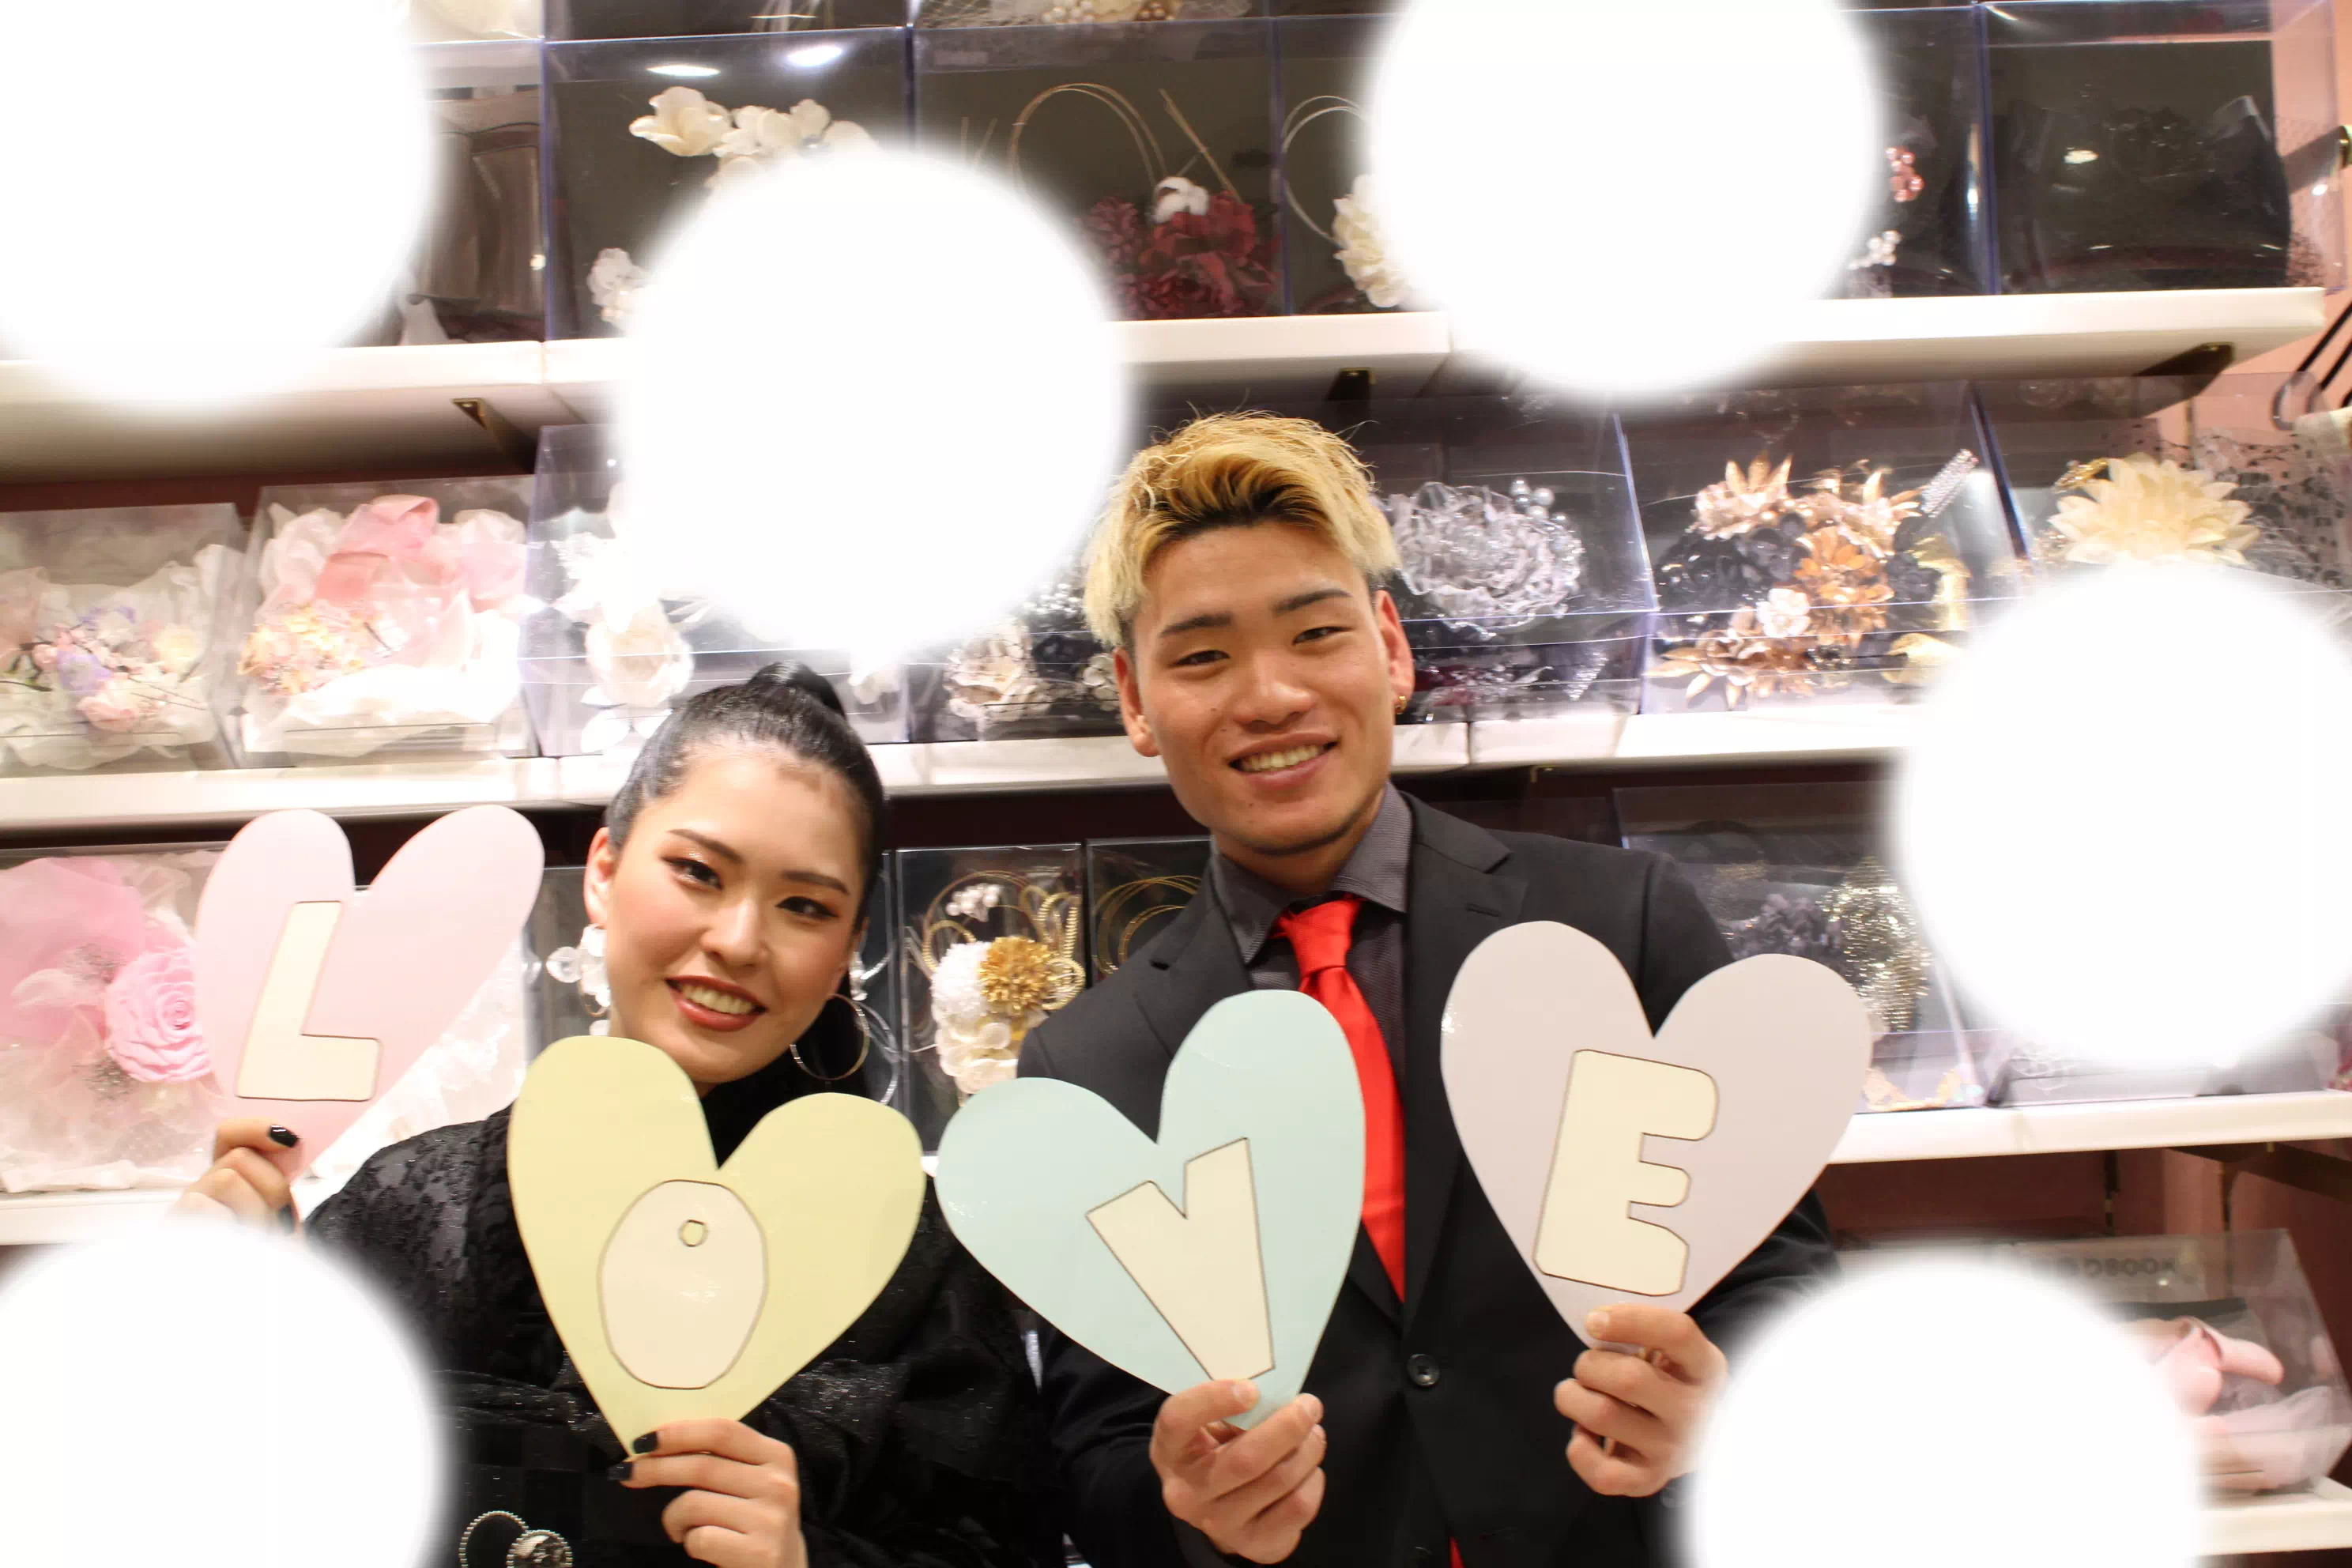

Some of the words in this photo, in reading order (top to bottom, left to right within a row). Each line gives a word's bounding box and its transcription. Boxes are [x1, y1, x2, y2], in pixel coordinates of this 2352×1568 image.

[236, 899, 383, 1102] L
[1085, 1136, 1276, 1382] V
[1532, 1048, 1721, 1298] E
